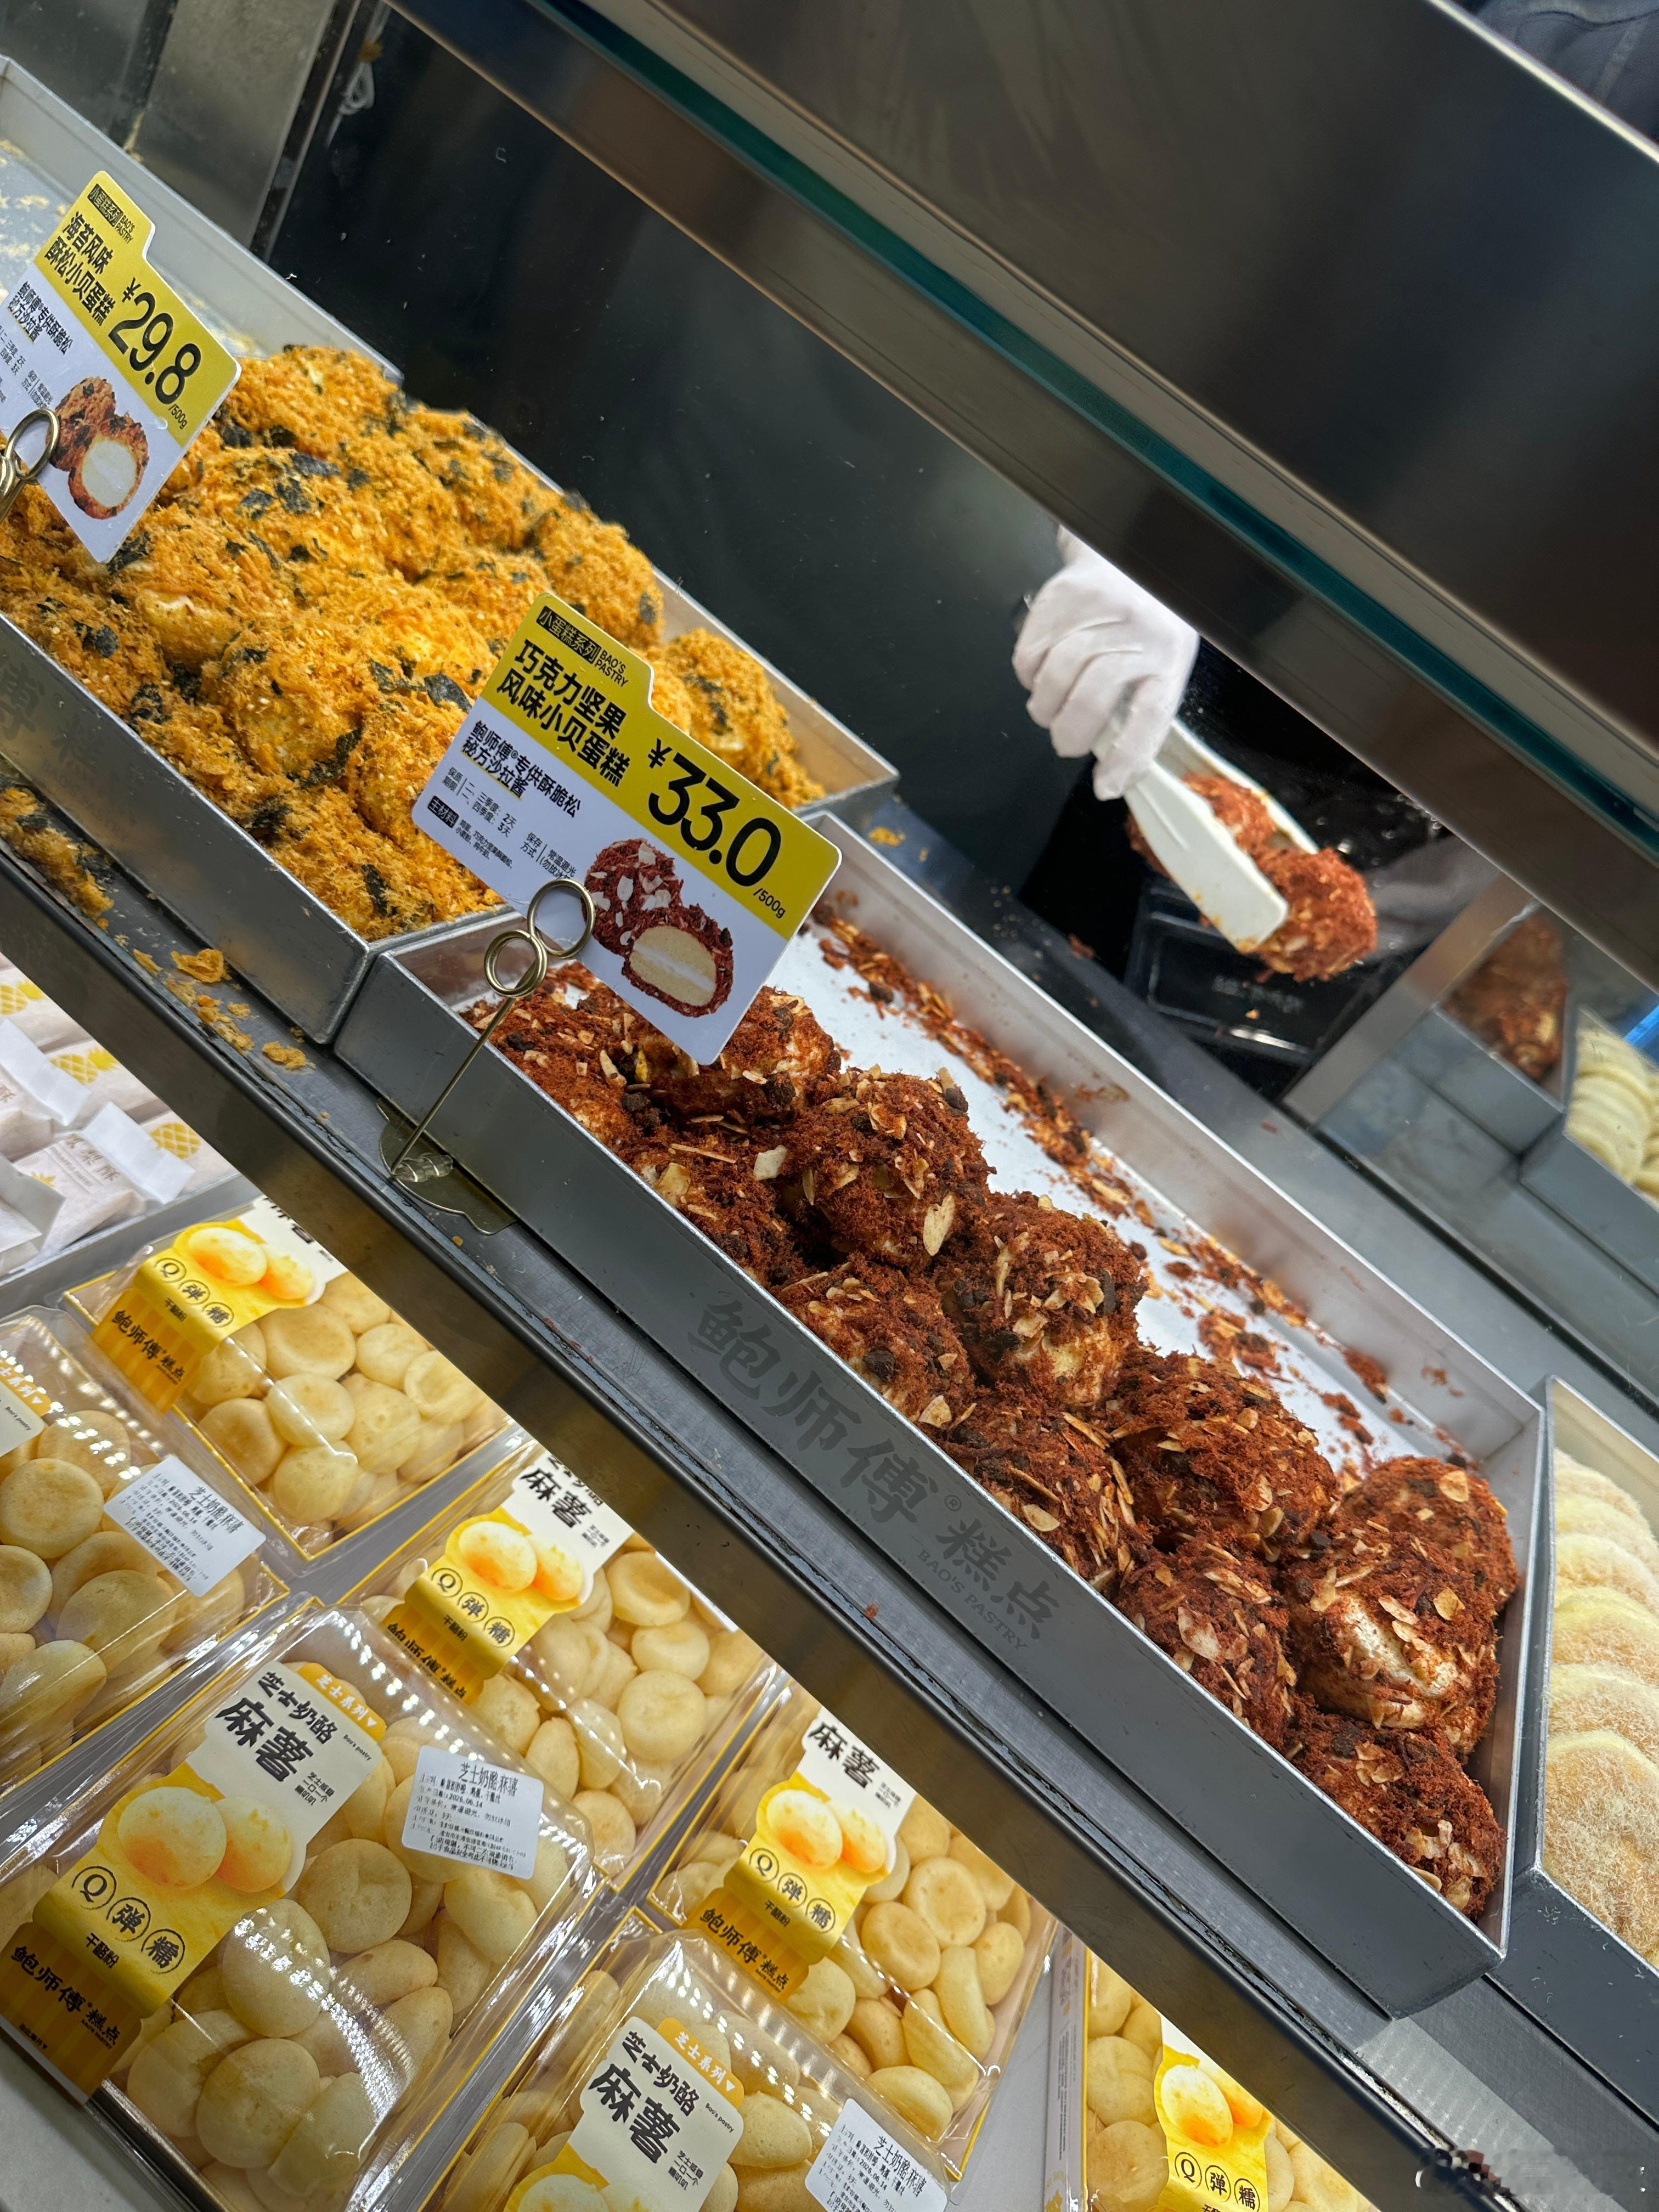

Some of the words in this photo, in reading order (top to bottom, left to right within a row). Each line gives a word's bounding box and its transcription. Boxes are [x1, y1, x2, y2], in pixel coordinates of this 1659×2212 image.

[63, 211, 114, 274] 海苔风味
[115, 223, 133, 244] PASTRY
[120, 215, 136, 233] BAO'S
[44, 236, 116, 326] 酥松小贝蛋糕
[168, 403, 188, 430] /500g
[538, 608, 601, 664] 小蛋糕系列
[595, 660, 629, 687] PASTRY
[600, 649, 626, 674] BAO'S
[514, 639, 627, 740] 巧克力坚果
[496, 668, 631, 787] 风味小贝蛋糕
[442, 775, 458, 793] 期限
[447, 766, 463, 782] 保质
[462, 736, 531, 799] 秘方沙拉酱
[427, 796, 459, 828] 主材料
[520, 840, 535, 859] 方式
[527, 832, 543, 849] 保存
[547, 849, 578, 878] 常温避光
[753, 888, 786, 919] /500g
[520, 1468, 592, 1528] 麻薯
[916, 1548, 966, 1594] BAO'S
[964, 1592, 1029, 1650] PASTRY
[257, 1671, 338, 1745] 芝士奶酪
[316, 1673, 370, 1721] 芝士系列
[215, 1697, 314, 1782] 麻薯
[343, 1734, 356, 1748] Bao's
[356, 1745, 373, 1761] pastry
[808, 1722, 880, 1788] 麻薯
[86, 1932, 120, 1969] 干酪粉
[622, 2030, 699, 2117] 芝士奶酪
[675, 2031, 727, 2085] 芝士系列
[588, 2063, 681, 2164] 麻薯
[705, 2102, 718, 2118] Bao's
[717, 2116, 735, 2134] pastry
[674, 2159, 699, 2186] 一口一个
